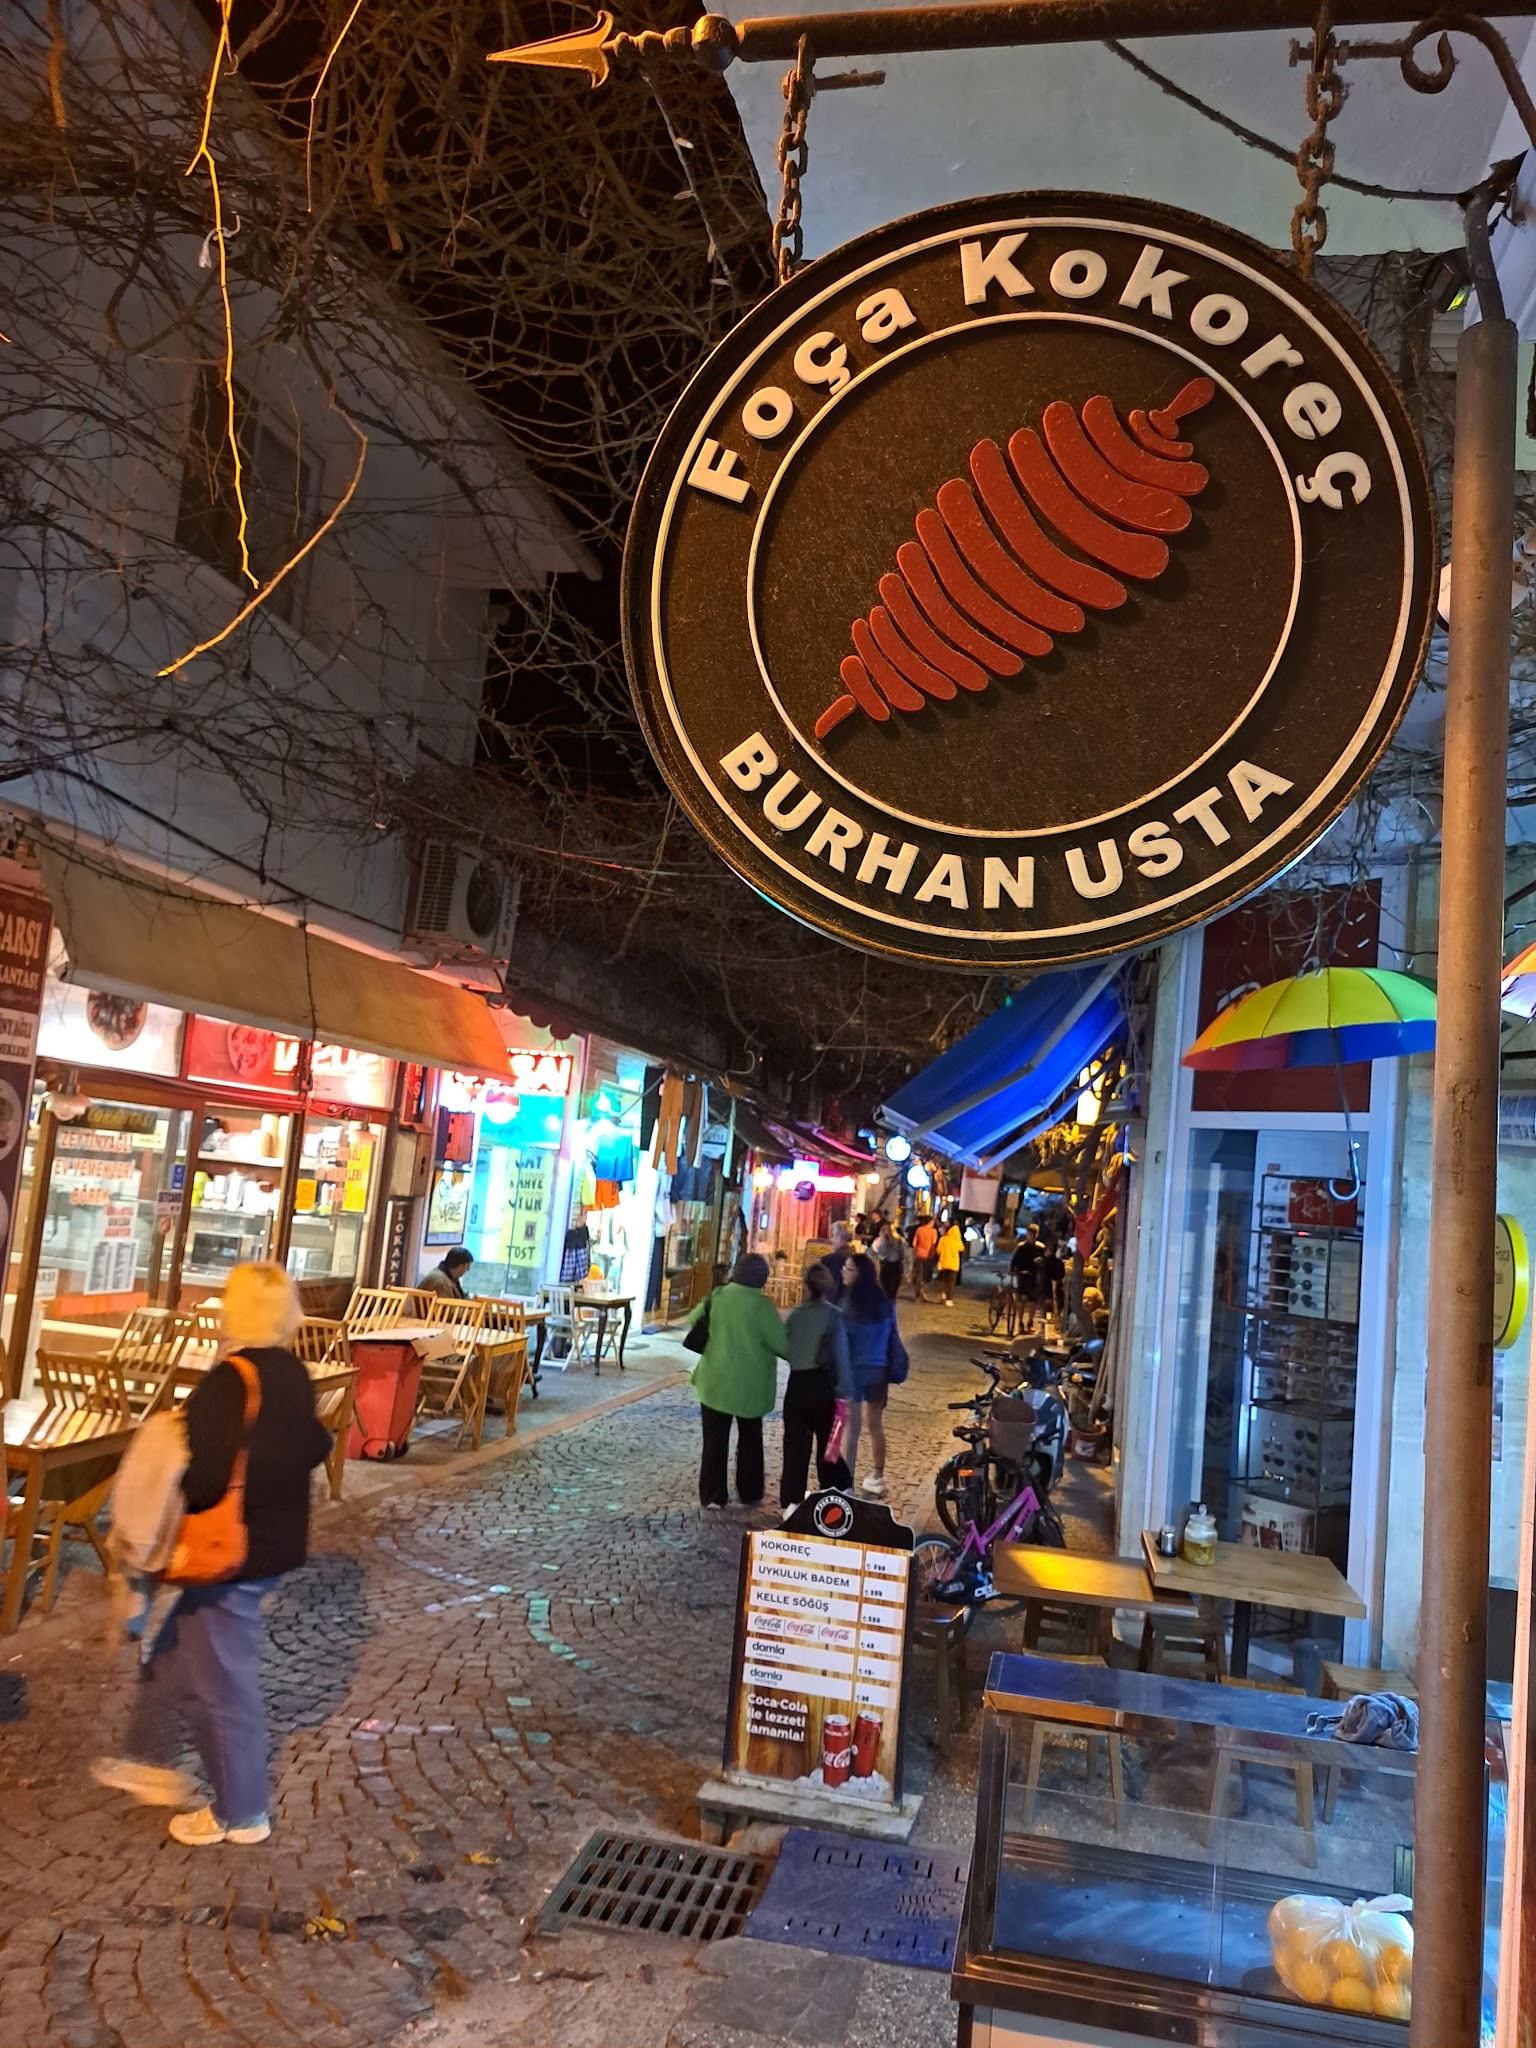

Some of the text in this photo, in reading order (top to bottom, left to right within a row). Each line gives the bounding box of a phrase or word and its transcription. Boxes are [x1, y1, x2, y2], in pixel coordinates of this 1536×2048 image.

[688, 232, 1371, 510] Foça Kokoreç
[719, 731, 1296, 910] BURHAN USTA
[0, 911, 42, 967] ARŞI
[506, 1245, 536, 1260] TOST
[761, 1540, 811, 1557] KOKOREÇ
[758, 1566, 850, 1588] UYKULUK BADEM
[756, 1591, 829, 1613] KELLE SÖĞÜŞ
[752, 1641, 785, 1655] damla
[750, 1668, 783, 1682] damla
